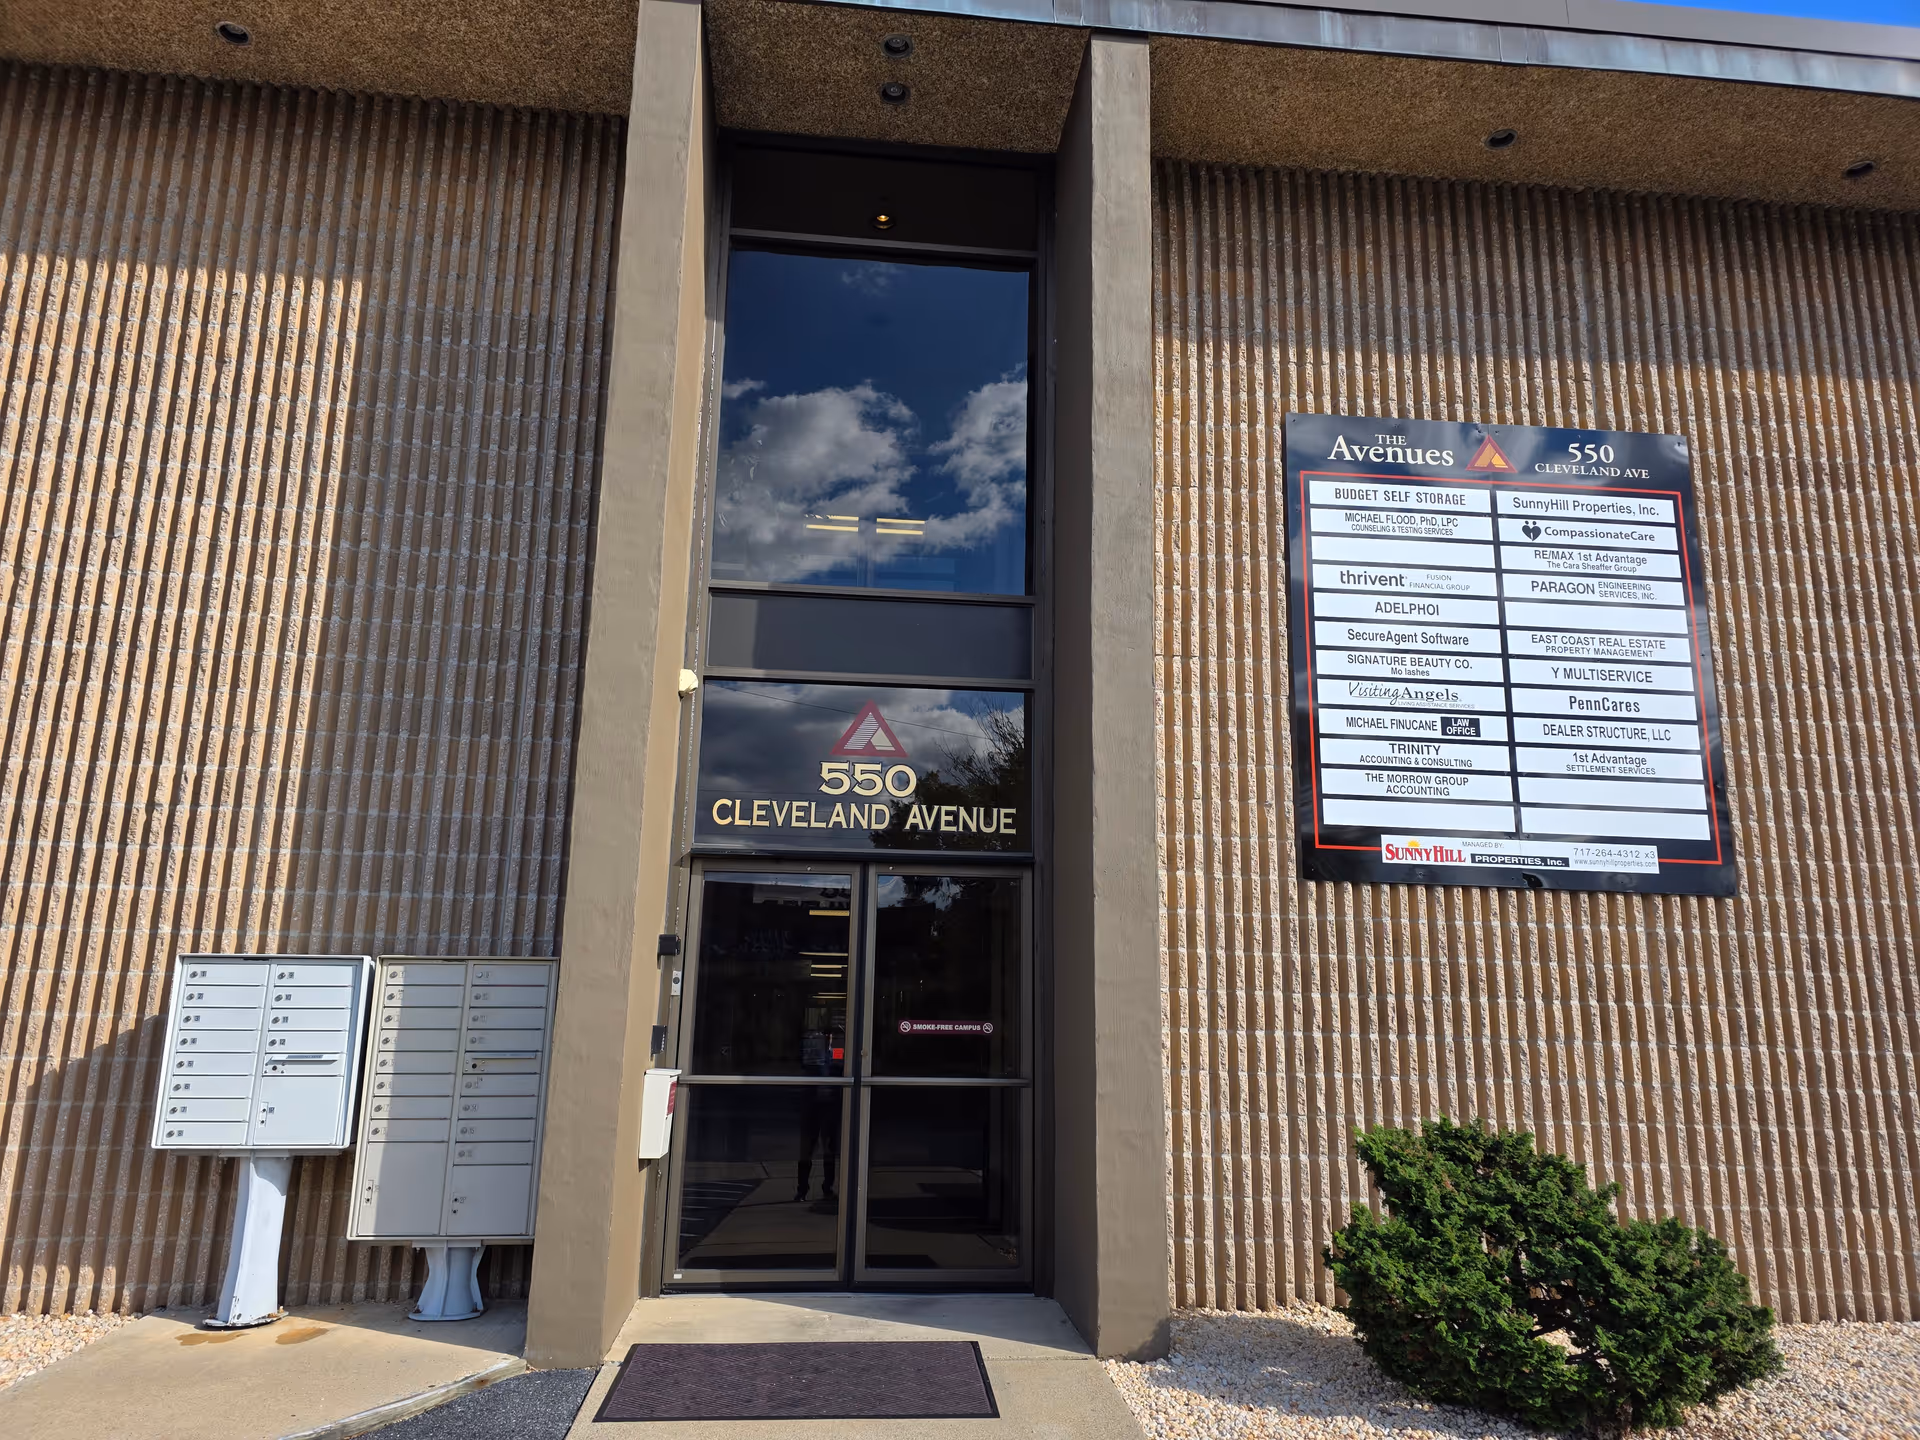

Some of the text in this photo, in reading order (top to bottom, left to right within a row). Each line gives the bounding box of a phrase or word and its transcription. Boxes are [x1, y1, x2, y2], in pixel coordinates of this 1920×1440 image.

[1375, 434, 1406, 445] THE
[1328, 435, 1454, 466] Avenues
[1568, 443, 1614, 463] 550
[1535, 463, 1649, 478] CLEVELAND AVE
[1334, 488, 1466, 505] BUDGET SELF STORAGE
[1513, 497, 1659, 516] SunnyHill Properties, Inc.
[1345, 513, 1458, 527] MICHAEL FLOOD, PhD, LPC
[1351, 524, 1390, 532] COUNSELING
[1397, 526, 1422, 534] TESTING
[1544, 527, 1655, 541] CompassionateCare
[1534, 550, 1647, 566] RE/MAX 1st Advantage
[1582, 563, 1612, 571] Sheaffer
[1614, 565, 1637, 573] Group
[1340, 570, 1405, 587] thrivent
[1531, 581, 1595, 594] PARAGON
[1598, 582, 1651, 591] ENGINEERING
[1599, 591, 1640, 600] SERVICES,
[1375, 602, 1439, 615] ADELPHOI
[1347, 629, 1469, 645] SecureAgent Software
[1532, 634, 1666, 649] EAST COAST REAL ESTATE
[1545, 646, 1653, 657] PROPERTY MANAGEMENT
[1347, 654, 1472, 669] SIGNATURE BEAUTY CO.
[1405, 668, 1430, 676] lashes
[1551, 667, 1653, 683] Y MULTISERVICE
[1349, 682, 1401, 705] Visiting
[1569, 696, 1640, 712] PennCares
[1346, 717, 1437, 731] MICHAEL FINUCANE
[1452, 718, 1470, 726] LAW
[1446, 727, 1476, 735] OFFICE
[1543, 724, 1671, 742] DEALER STRUCTURE, LLC
[1389, 743, 1441, 755] TRINITY
[1360, 755, 1411, 765] ACCOUNTING
[1422, 758, 1473, 767] CONSULTING
[1573, 752, 1647, 767] 1st Advantage
[1566, 764, 1656, 775] SETTLEMENT SERVICES
[818, 760, 917, 798] 550
[1365, 773, 1468, 786] THE MORROW GROUP
[1386, 785, 1450, 796] ACCOUNTING
[712, 798, 1017, 835] CLEVELAND AVENUE
[1574, 848, 1640, 858] 717-264-4312
[1475, 856, 1544, 866] PROPERTIES,
[1574, 859, 1657, 867] www.sunnyhillproperties.com
